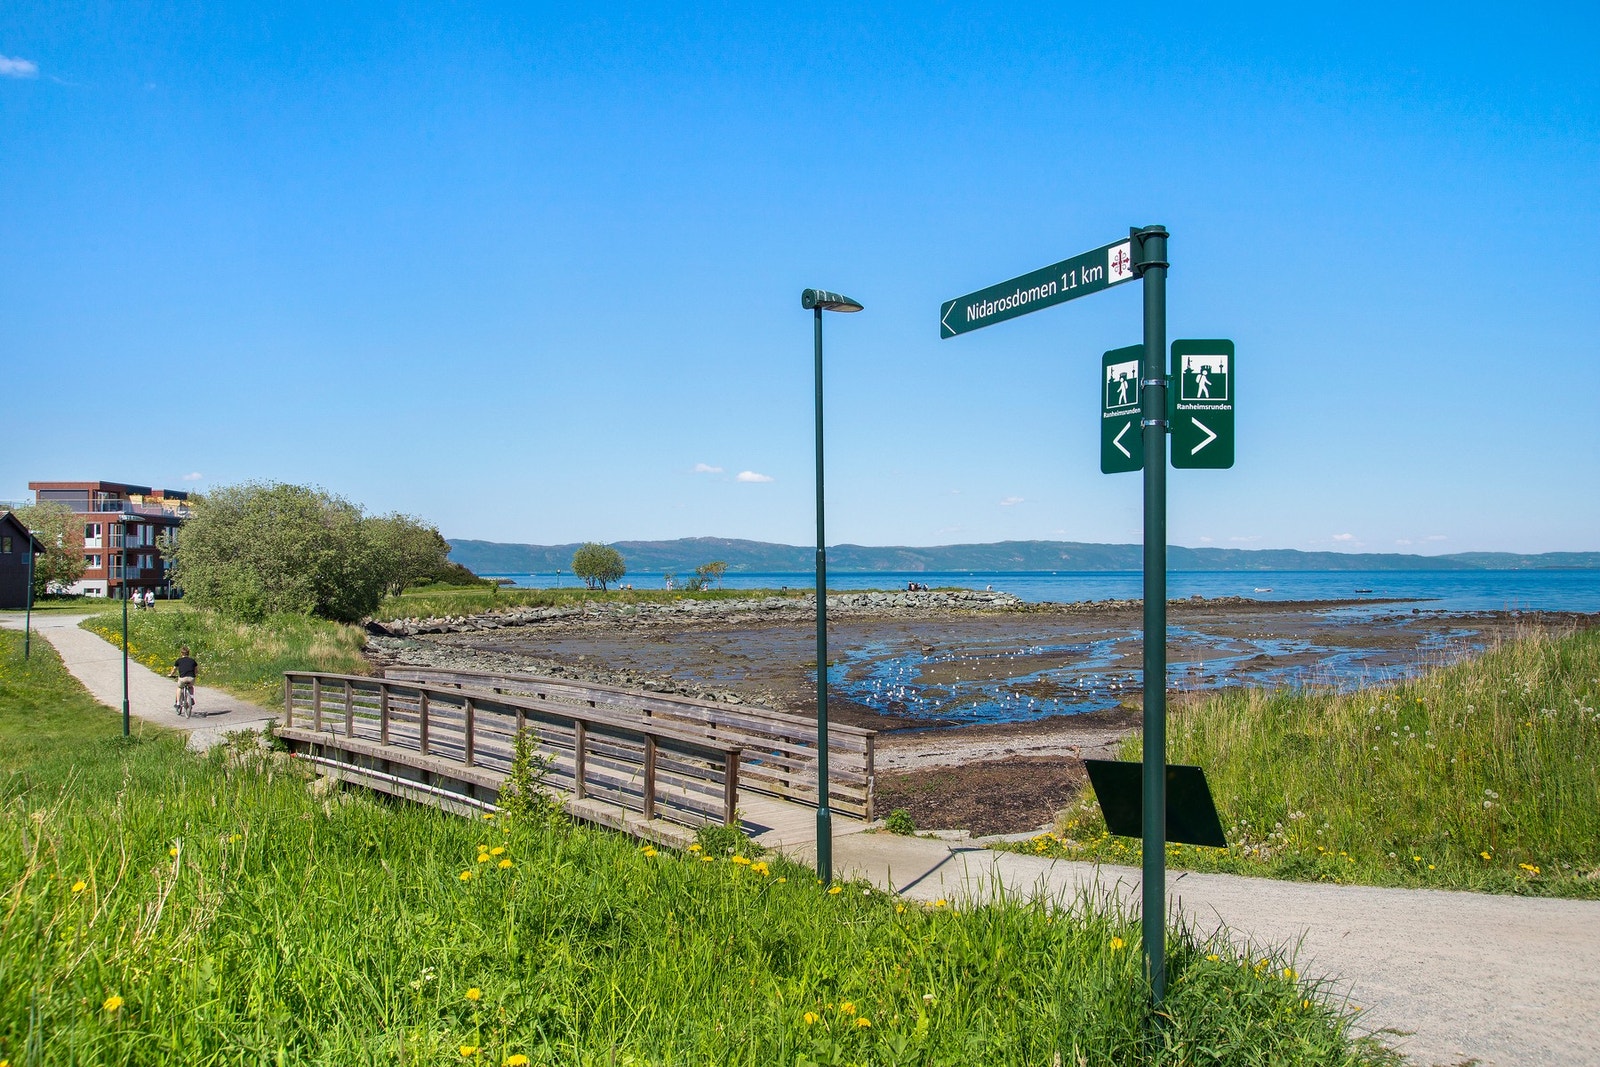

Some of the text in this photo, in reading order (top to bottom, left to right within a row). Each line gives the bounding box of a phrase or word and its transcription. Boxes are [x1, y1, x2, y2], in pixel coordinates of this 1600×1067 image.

[967, 264, 1103, 322] Nidarosdomen 11 km
[1103, 407, 1141, 418] Ranheimsrunden
[1176, 403, 1232, 411] Ranheimsrunden
